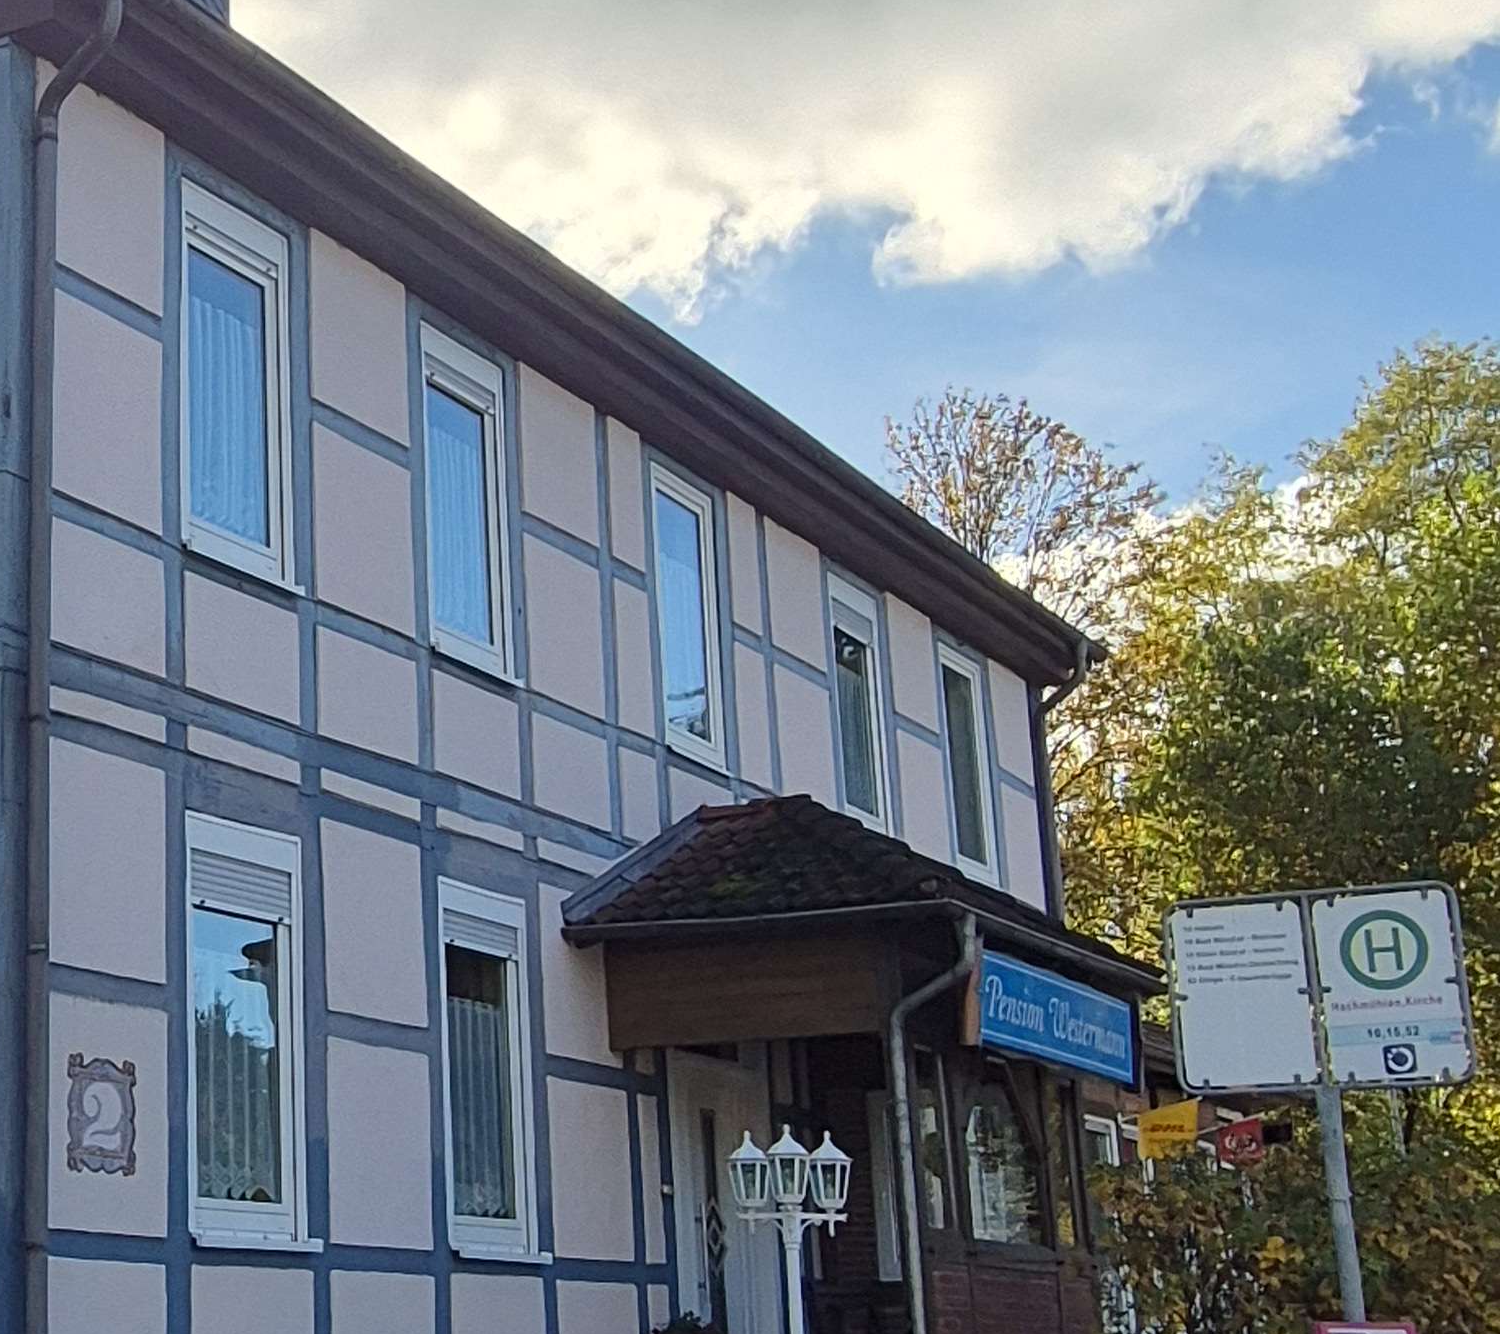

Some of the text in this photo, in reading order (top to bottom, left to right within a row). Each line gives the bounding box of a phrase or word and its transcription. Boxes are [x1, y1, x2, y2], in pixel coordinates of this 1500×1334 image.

[1364, 927, 1404, 973] H
[985, 975, 1126, 1059] Pension Westermann
[82, 1080, 124, 1151] 2
